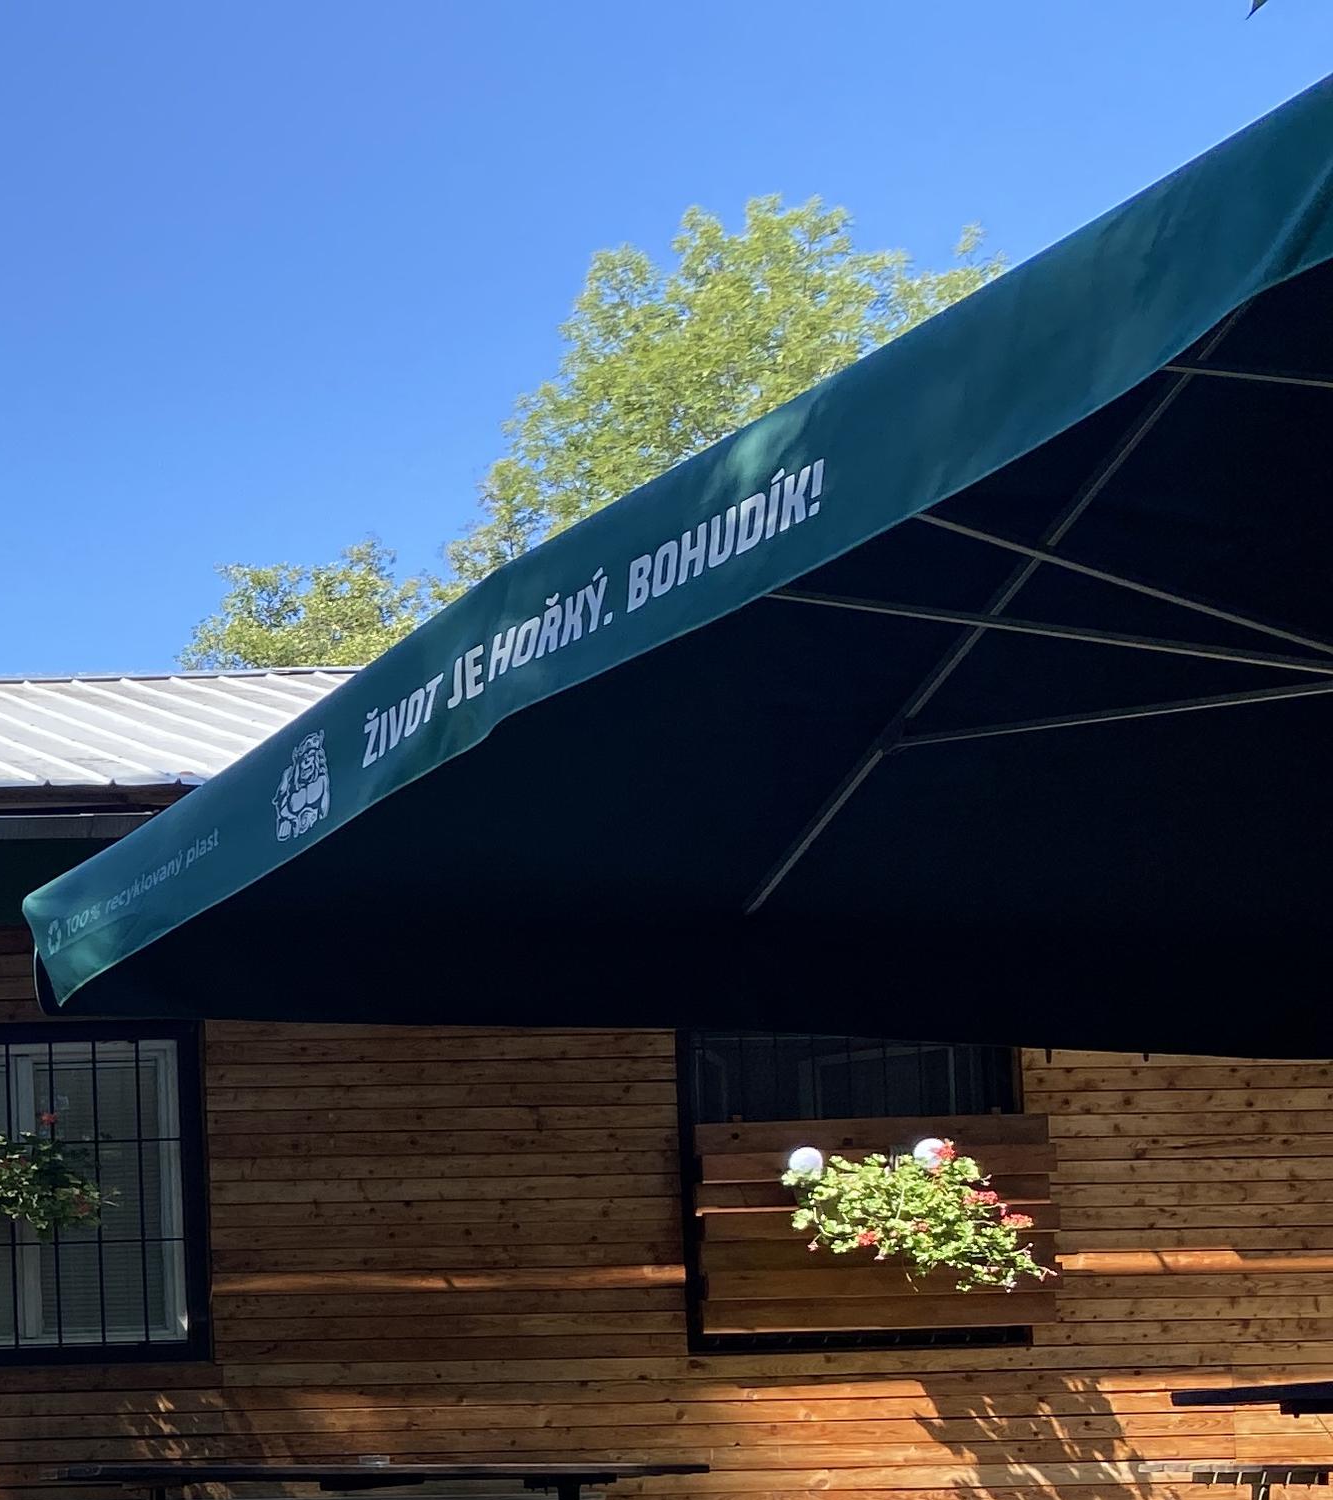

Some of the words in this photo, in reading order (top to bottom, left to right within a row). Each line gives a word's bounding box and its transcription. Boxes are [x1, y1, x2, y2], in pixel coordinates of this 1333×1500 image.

[362, 672, 444, 769] ŽIVOT
[447, 644, 485, 709] JE
[487, 566, 614, 683] HOŘKÝ.
[626, 457, 825, 613] BOHUDÍK!
[66, 902, 102, 937] 100%
[105, 850, 183, 915] recyklovaný
[185, 827, 220, 869] plast
